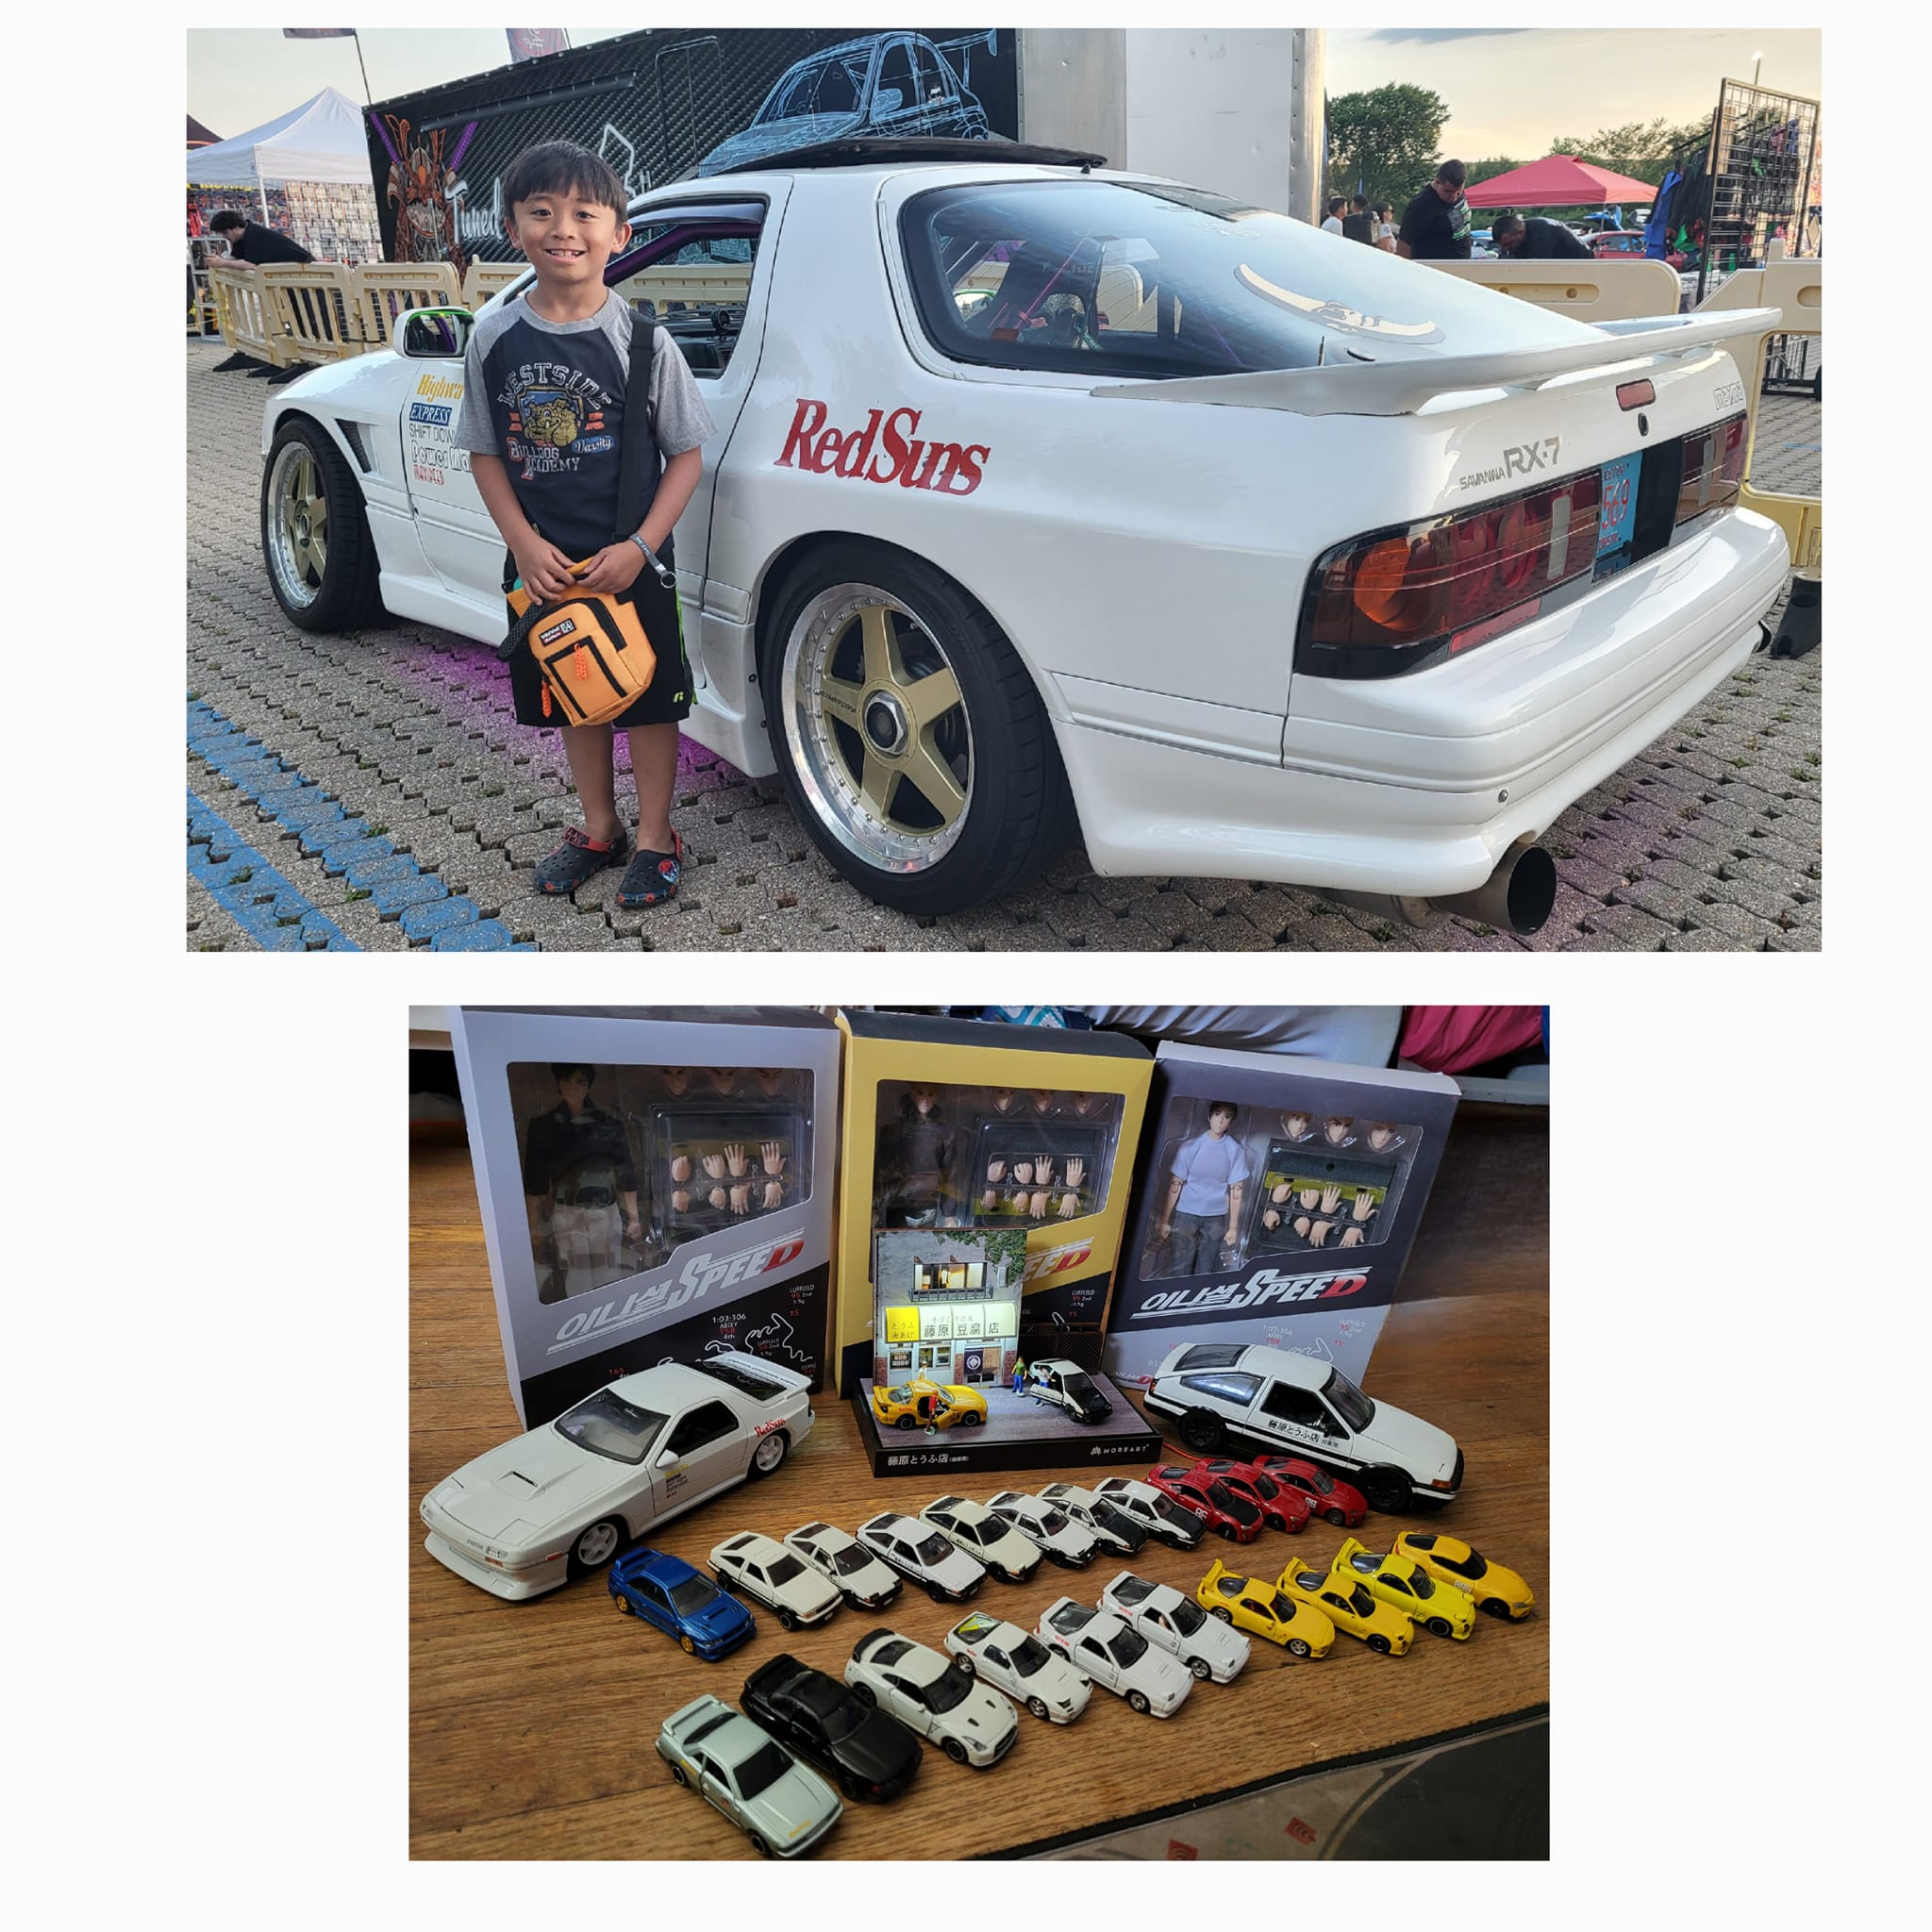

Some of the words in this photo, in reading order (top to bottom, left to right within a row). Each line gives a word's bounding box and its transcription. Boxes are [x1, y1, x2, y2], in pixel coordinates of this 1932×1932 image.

[409, 404, 451, 425] EXPRESS
[408, 423, 431, 440] SHIFT
[774, 398, 991, 496] RedSuns
[1459, 466, 1506, 491] SAVANNA
